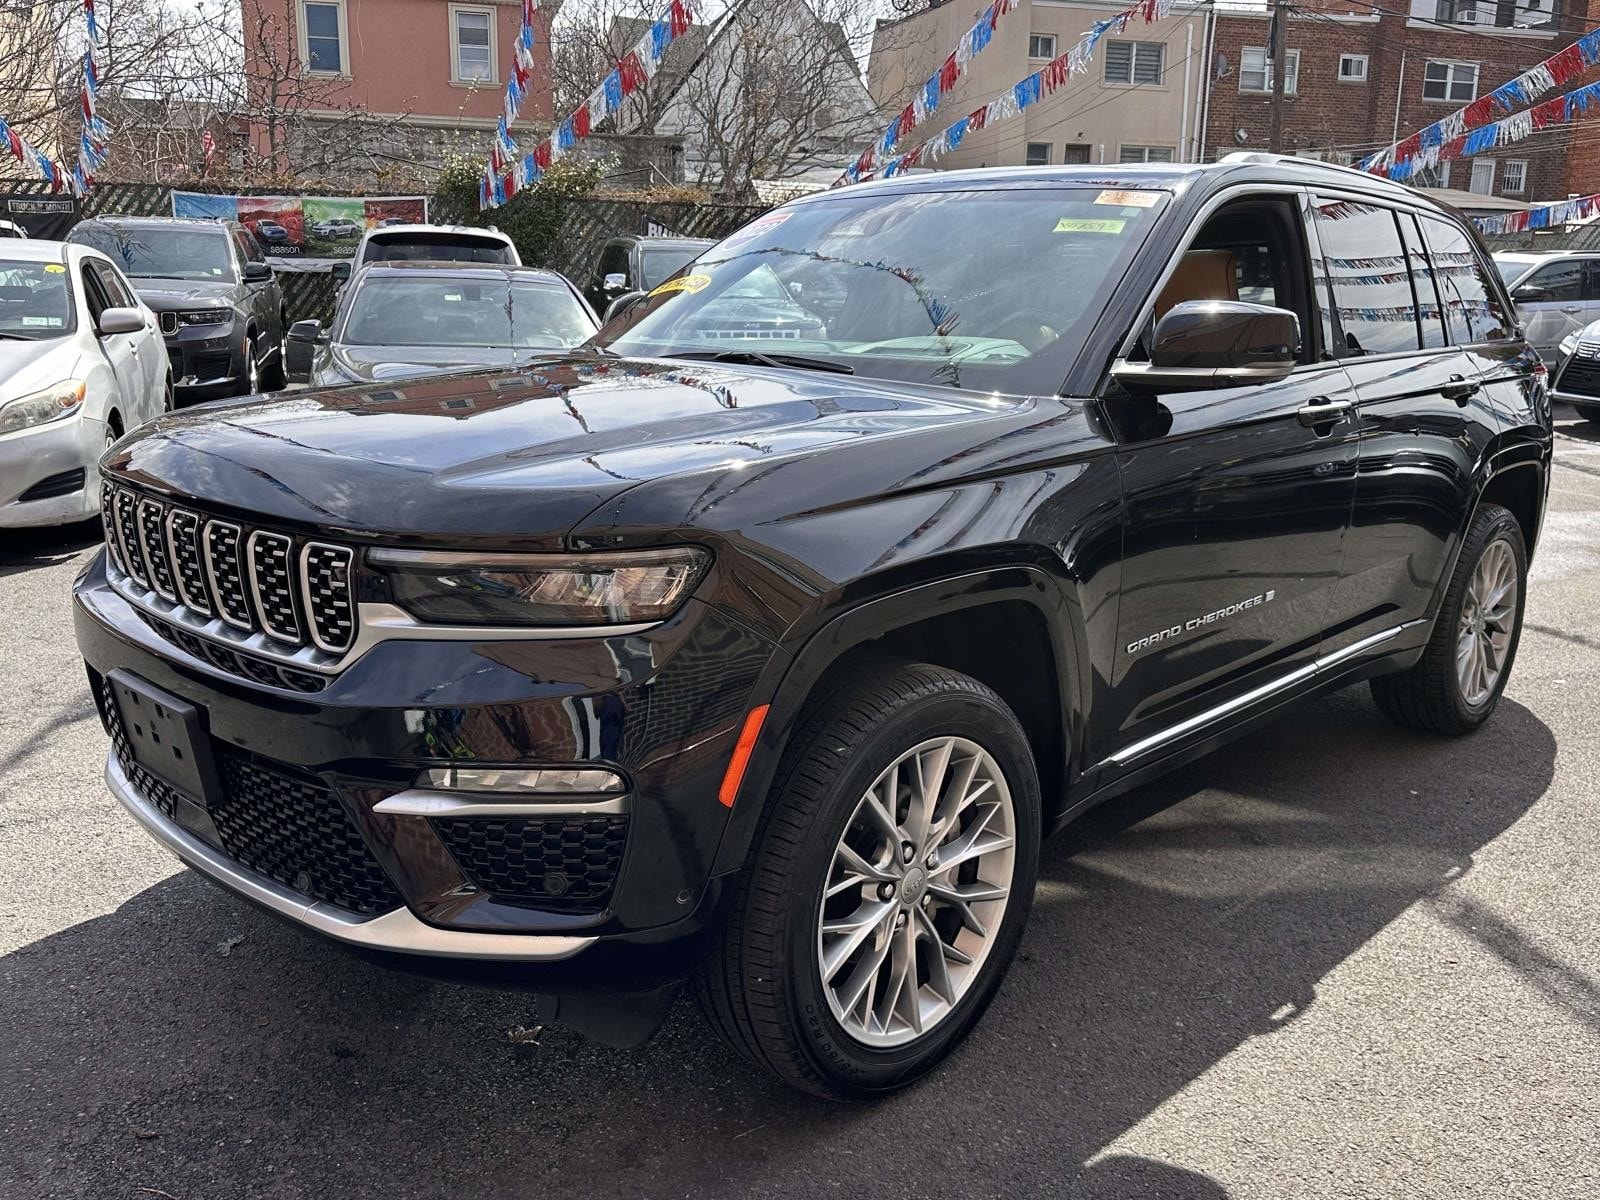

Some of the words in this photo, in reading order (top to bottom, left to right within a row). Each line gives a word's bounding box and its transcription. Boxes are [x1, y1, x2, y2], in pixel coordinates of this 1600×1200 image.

[12, 202, 36, 212] TRUCK
[45, 203, 70, 212] MONTH
[369, 204, 382, 214] It's
[270, 245, 303, 254] season.
[1126, 625, 1182, 654] GRAND
[1184, 594, 1263, 632] CHEROKEE
